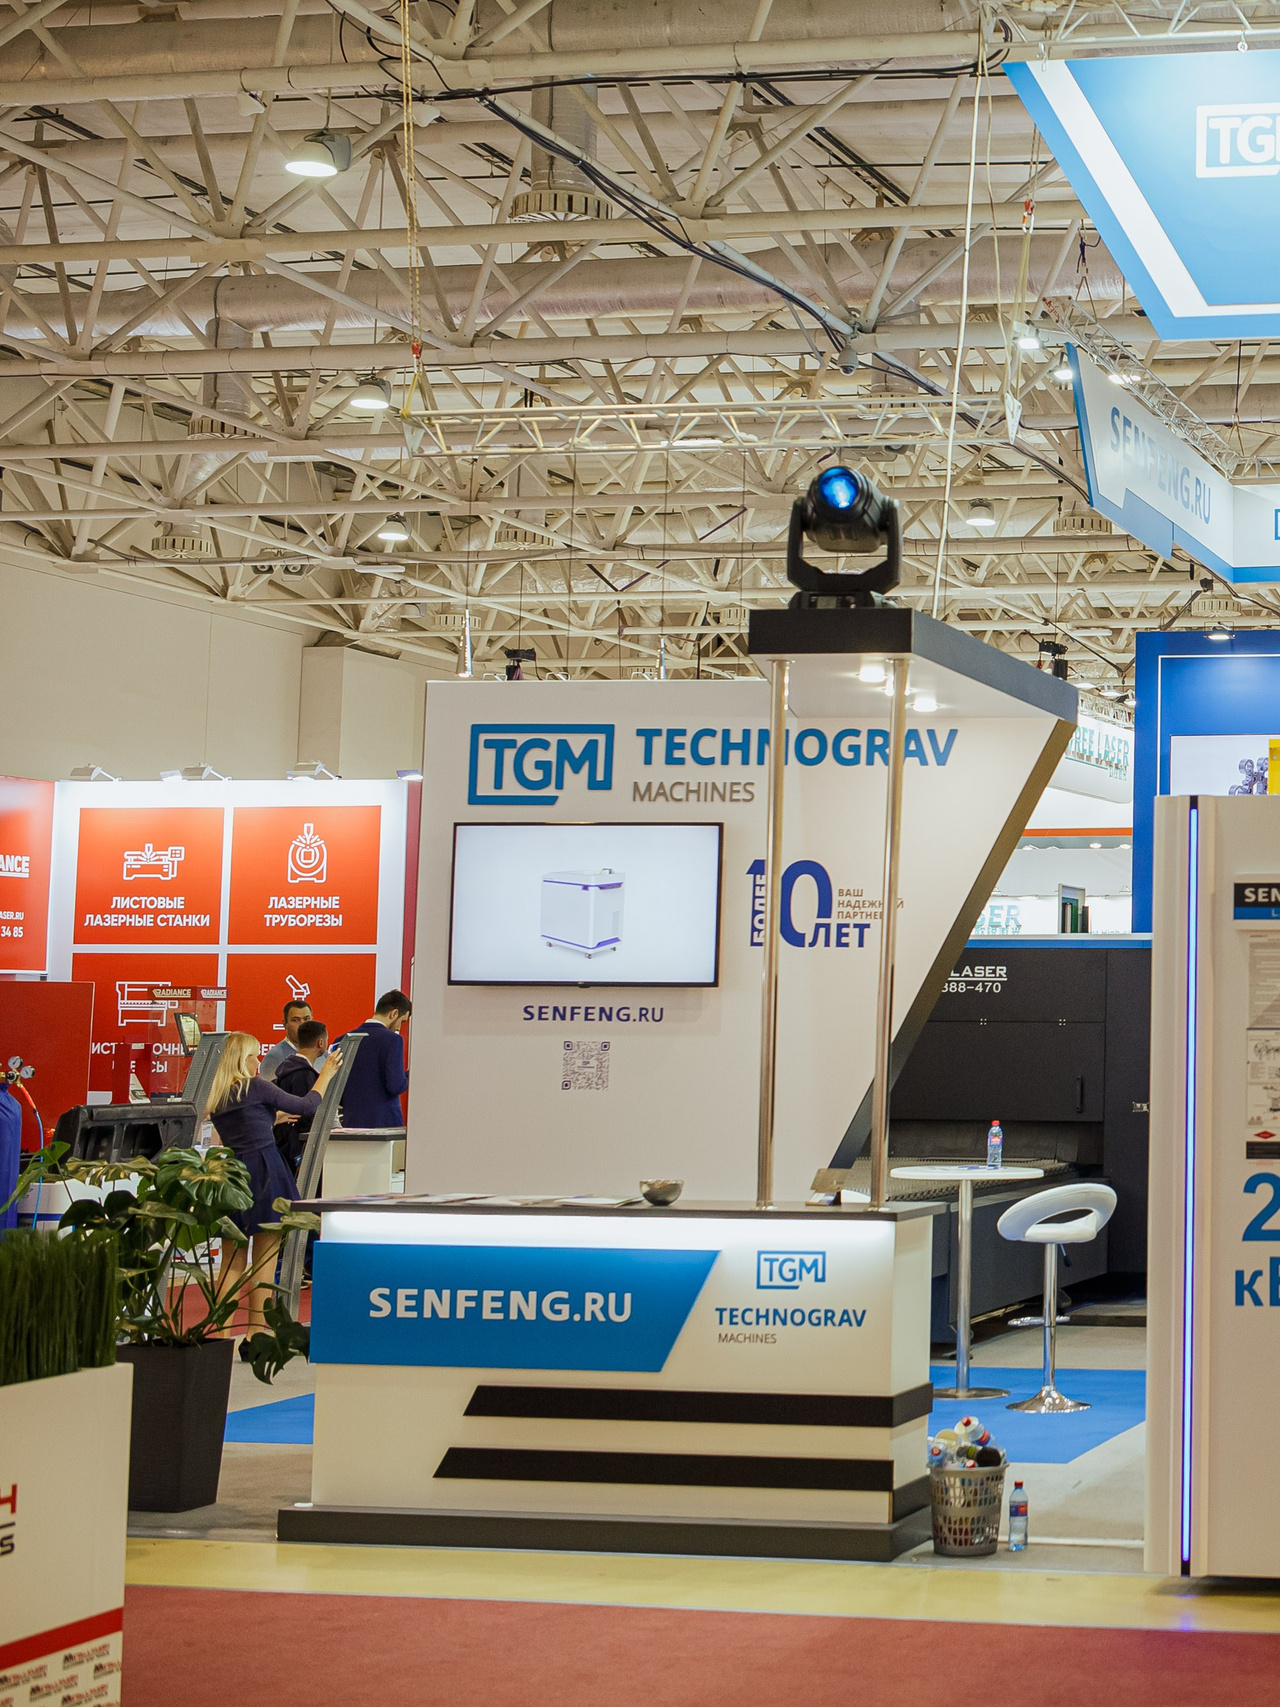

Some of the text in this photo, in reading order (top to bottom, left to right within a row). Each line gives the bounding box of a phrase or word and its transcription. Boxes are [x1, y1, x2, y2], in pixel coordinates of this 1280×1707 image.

[1110, 405, 1212, 525] SENFENG.RU
[478, 732, 610, 797] TGM
[632, 781, 755, 803] MACHINES
[838, 888, 864, 897] ВАШ
[110, 896, 185, 909] ЛИСТОВЫЕ
[268, 896, 340, 909] ЛАЗЕРНЫЕ
[837, 898, 904, 910] НАДЕЖНЙ
[84, 914, 210, 927] ЛАЗЕРНЫЕ СТАНКИ
[263, 914, 343, 927] ТРУБОРЕЗЫ
[0, 926, 24, 938] 34 85
[808, 923, 871, 948] ЛЕТ
[153, 989, 192, 997] RADIANCE
[522, 1005, 664, 1024] SENFENG.RU
[761, 1255, 823, 1287] TGM
[369, 1286, 632, 1323] SENFENG.RU
[715, 1307, 867, 1329] TECHNOGRAV
[718, 1332, 777, 1345] MACHINES
